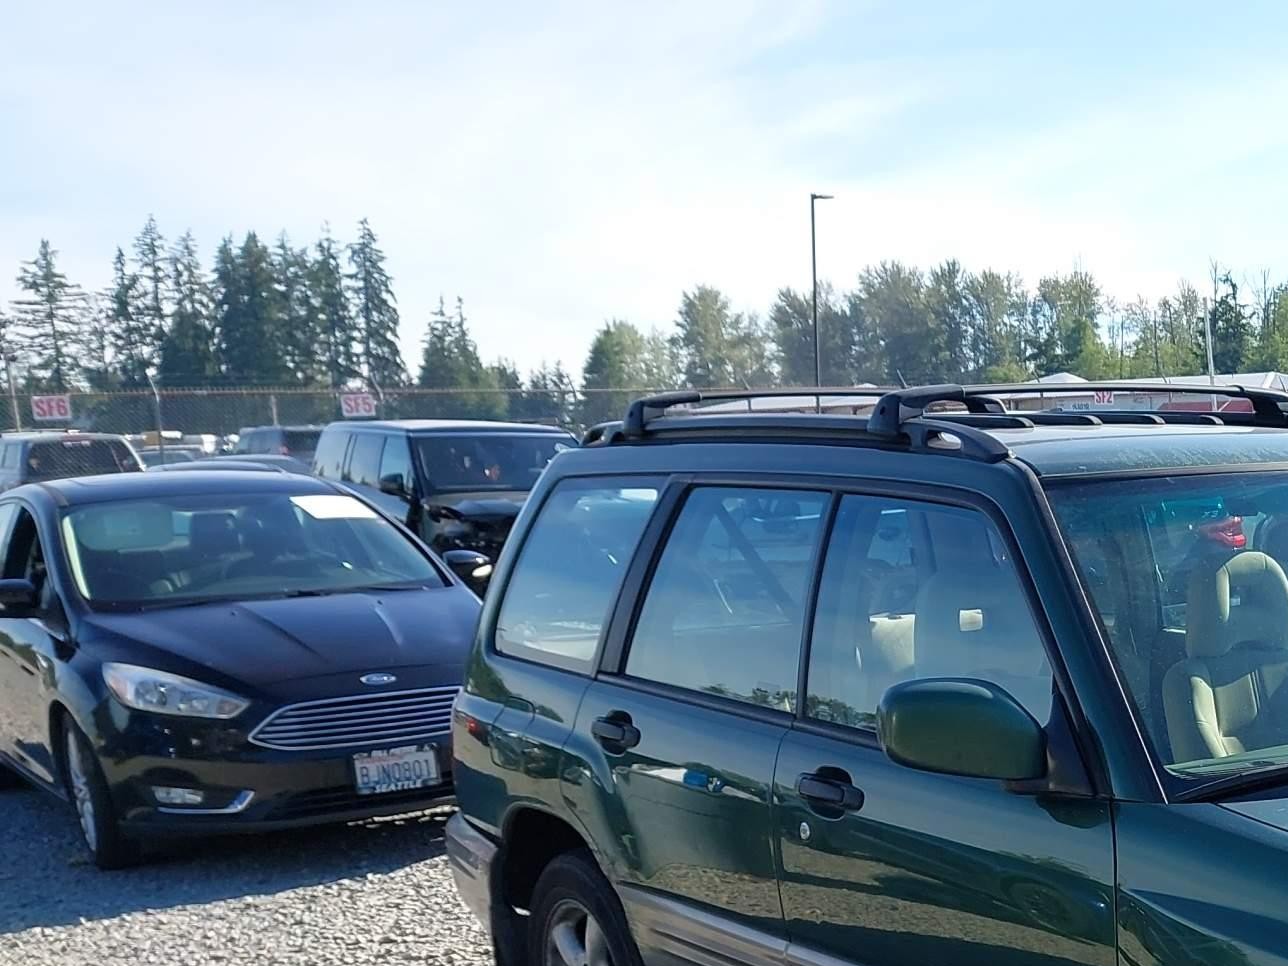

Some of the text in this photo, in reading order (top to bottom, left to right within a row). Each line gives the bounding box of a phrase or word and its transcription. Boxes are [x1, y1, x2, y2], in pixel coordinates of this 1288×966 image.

[34, 398, 69, 417] SF6
[343, 396, 373, 413] SF5
[374, 778, 423, 793] SEATTLE
